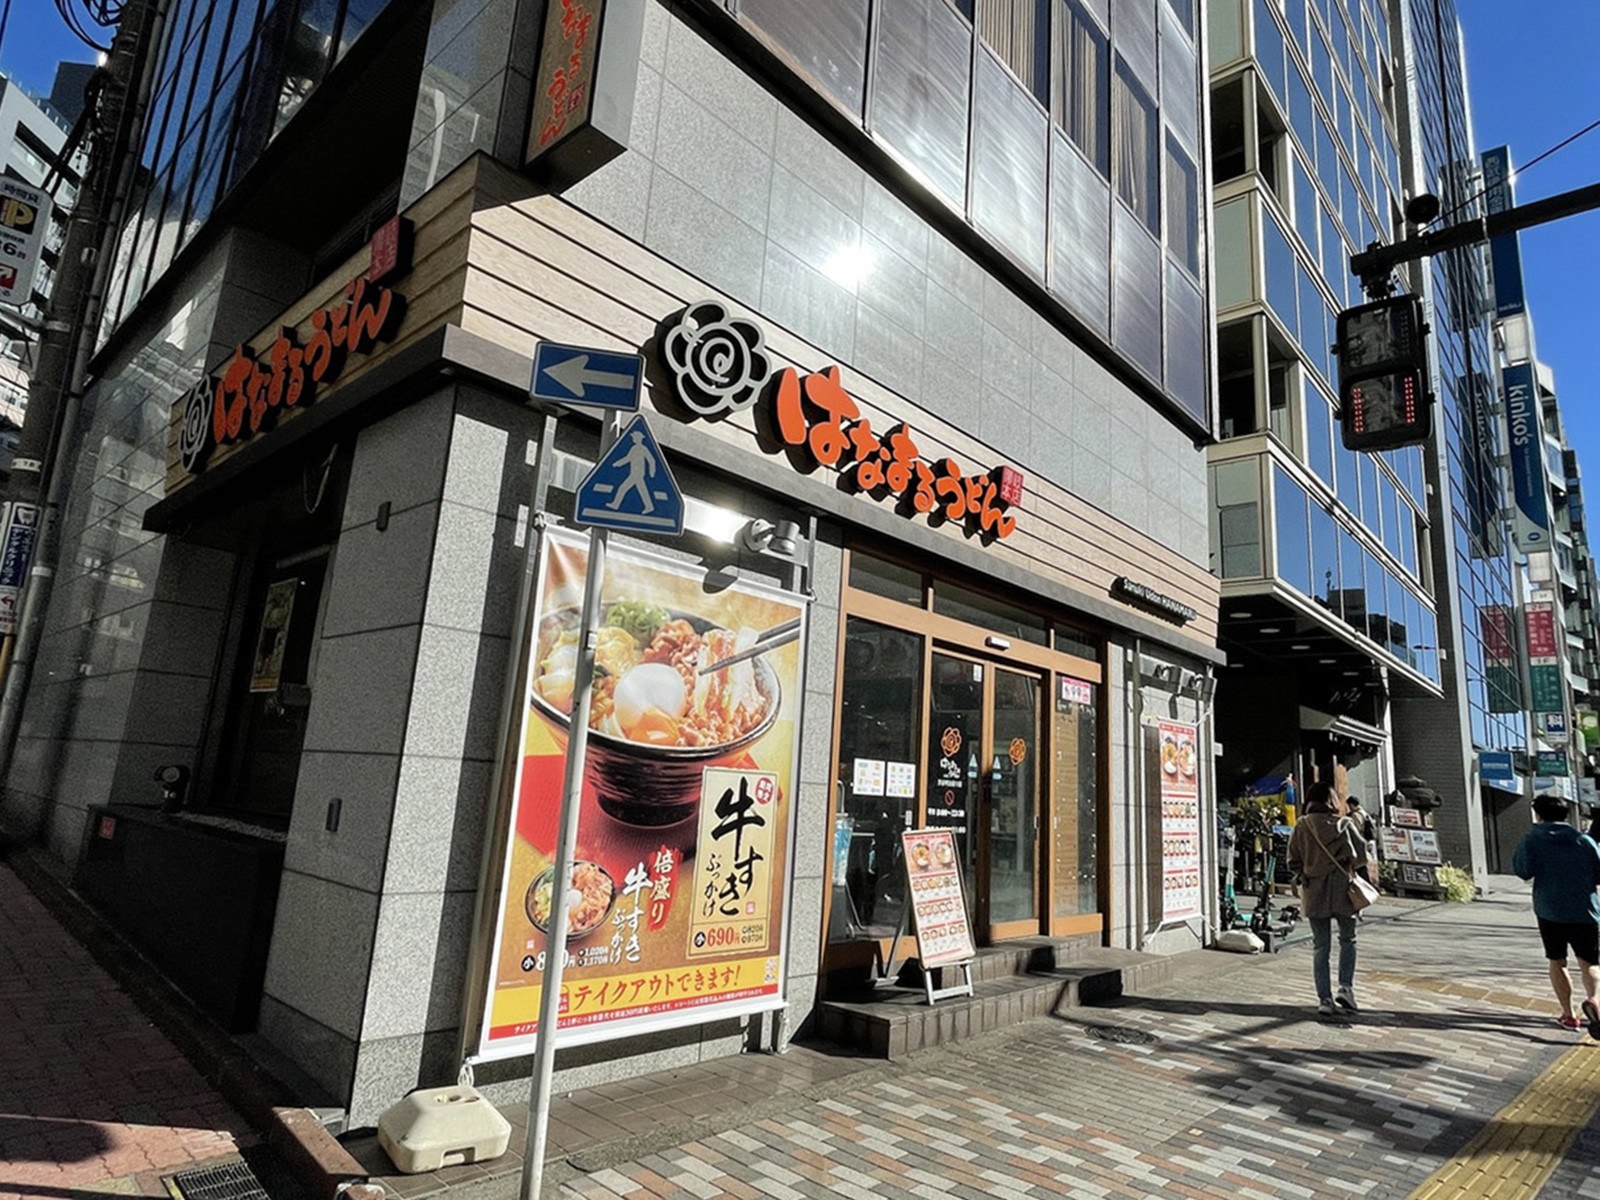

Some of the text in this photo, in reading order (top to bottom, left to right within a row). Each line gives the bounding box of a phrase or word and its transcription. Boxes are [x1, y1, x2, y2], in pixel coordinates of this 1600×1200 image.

[214, 276, 392, 444] はなまるうどん
[777, 365, 1016, 538] はなまるうどん
[650, 850, 675, 925] 倍盛り
[702, 853, 722, 919] ぶっかけ
[711, 775, 766, 917] 牛すき
[610, 908, 627, 965] ぶっかけ
[622, 861, 653, 963] 牛すき
